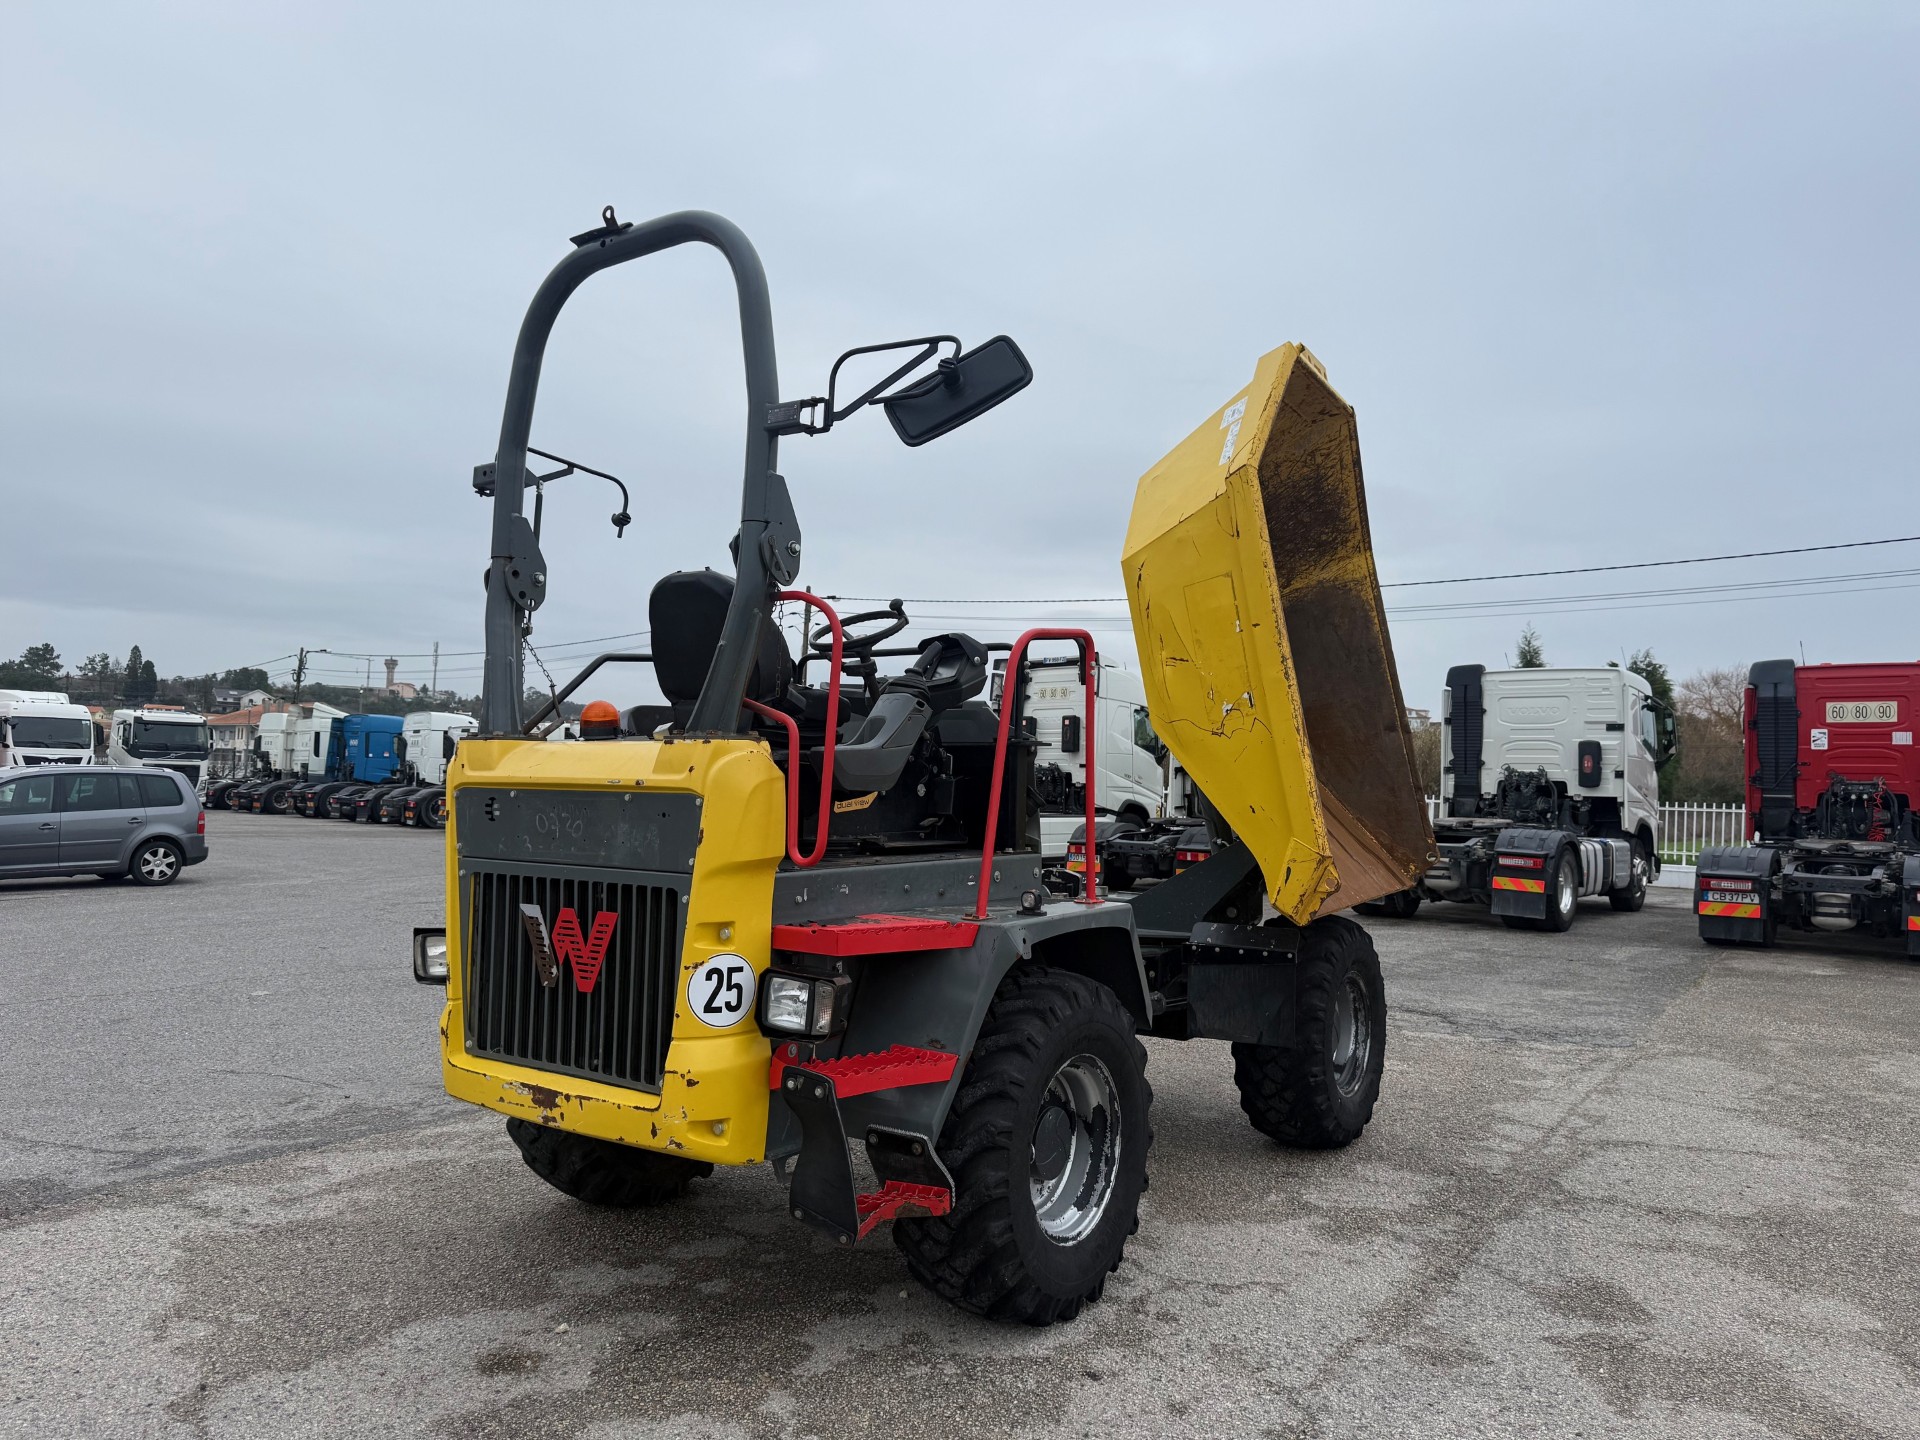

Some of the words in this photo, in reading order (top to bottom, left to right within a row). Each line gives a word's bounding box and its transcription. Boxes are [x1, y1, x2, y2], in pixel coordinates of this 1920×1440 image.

[1504, 705, 1561, 716] VOLVO
[1831, 705, 1845, 719] 60
[1854, 705, 1868, 719] 80
[1878, 705, 1892, 719] 90
[702, 966, 745, 1014] 25
